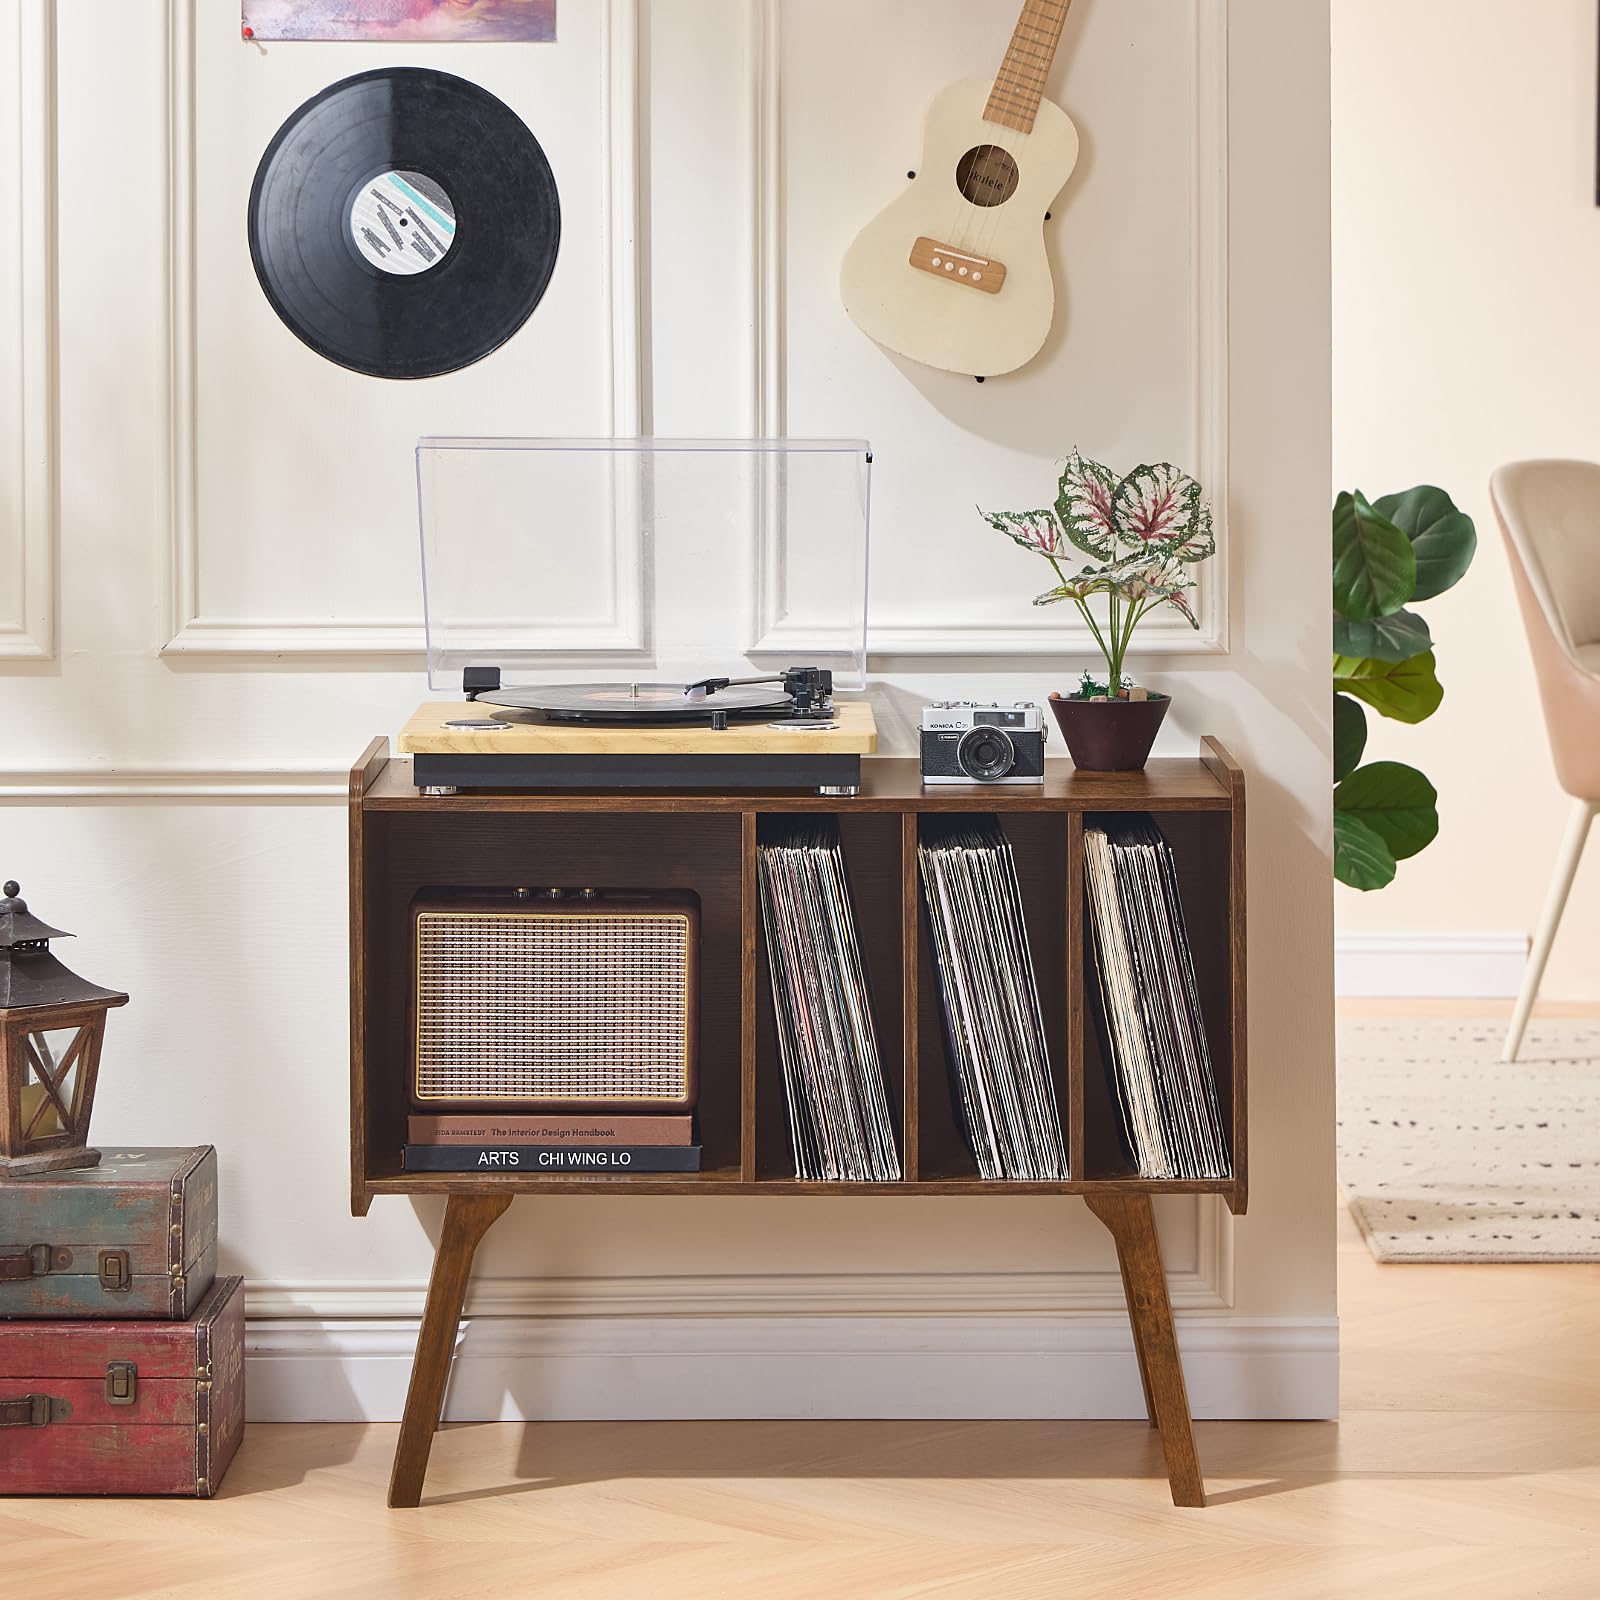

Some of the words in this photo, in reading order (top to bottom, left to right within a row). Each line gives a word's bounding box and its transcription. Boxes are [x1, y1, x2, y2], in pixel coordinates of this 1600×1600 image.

[491, 1128, 507, 1136] The
[508, 1128, 540, 1136] Interior
[541, 1128, 571, 1138] Design
[572, 1128, 616, 1136] Handbook
[477, 1151, 519, 1165] ARTS
[538, 1152, 564, 1165] CHI
[567, 1152, 608, 1165] WING
[611, 1152, 631, 1165] LO
